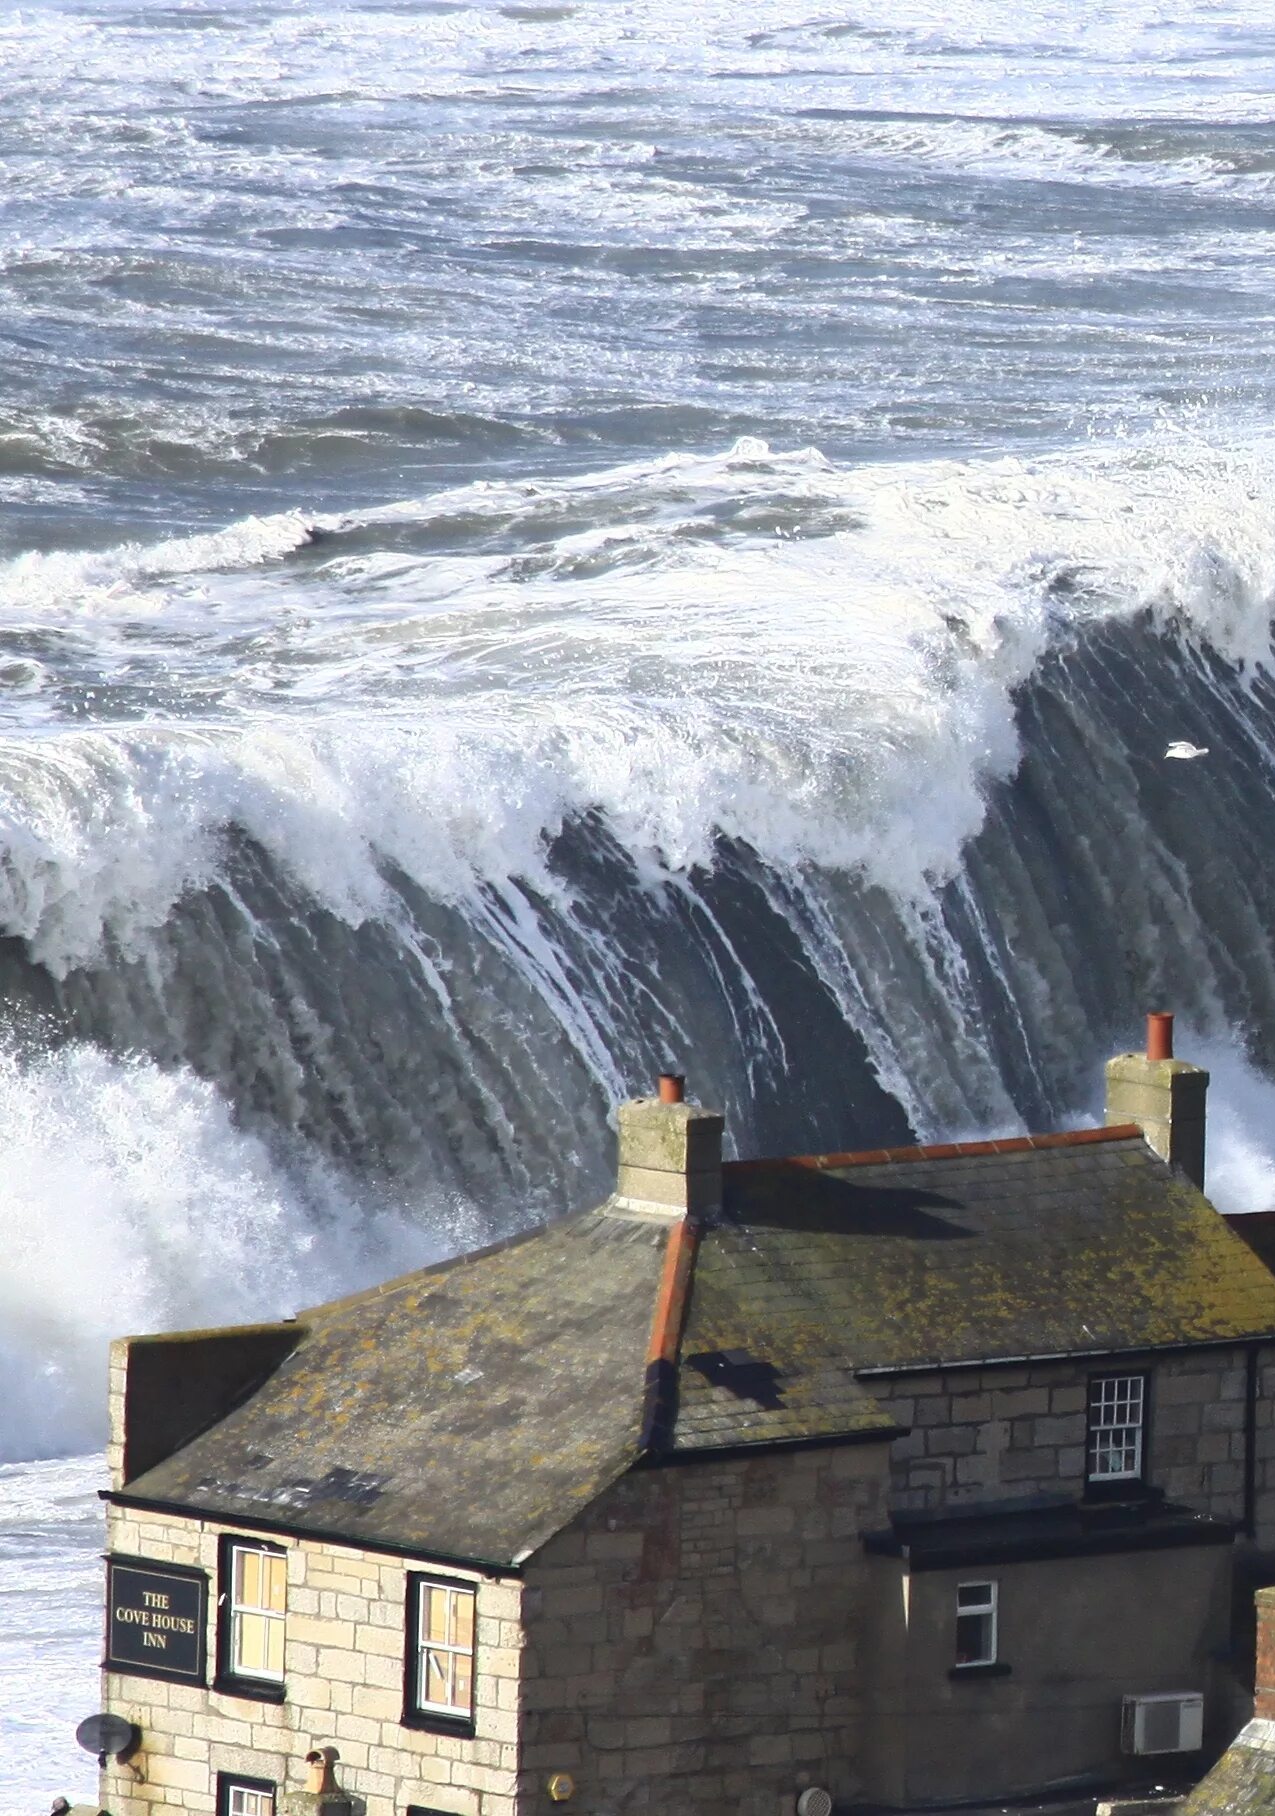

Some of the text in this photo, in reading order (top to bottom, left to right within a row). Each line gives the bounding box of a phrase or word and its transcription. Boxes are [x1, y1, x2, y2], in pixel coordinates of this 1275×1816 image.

[143, 1591, 169, 1609] THE
[116, 1607, 195, 1634] COVE HOUSE
[143, 1632, 167, 1649] INN
